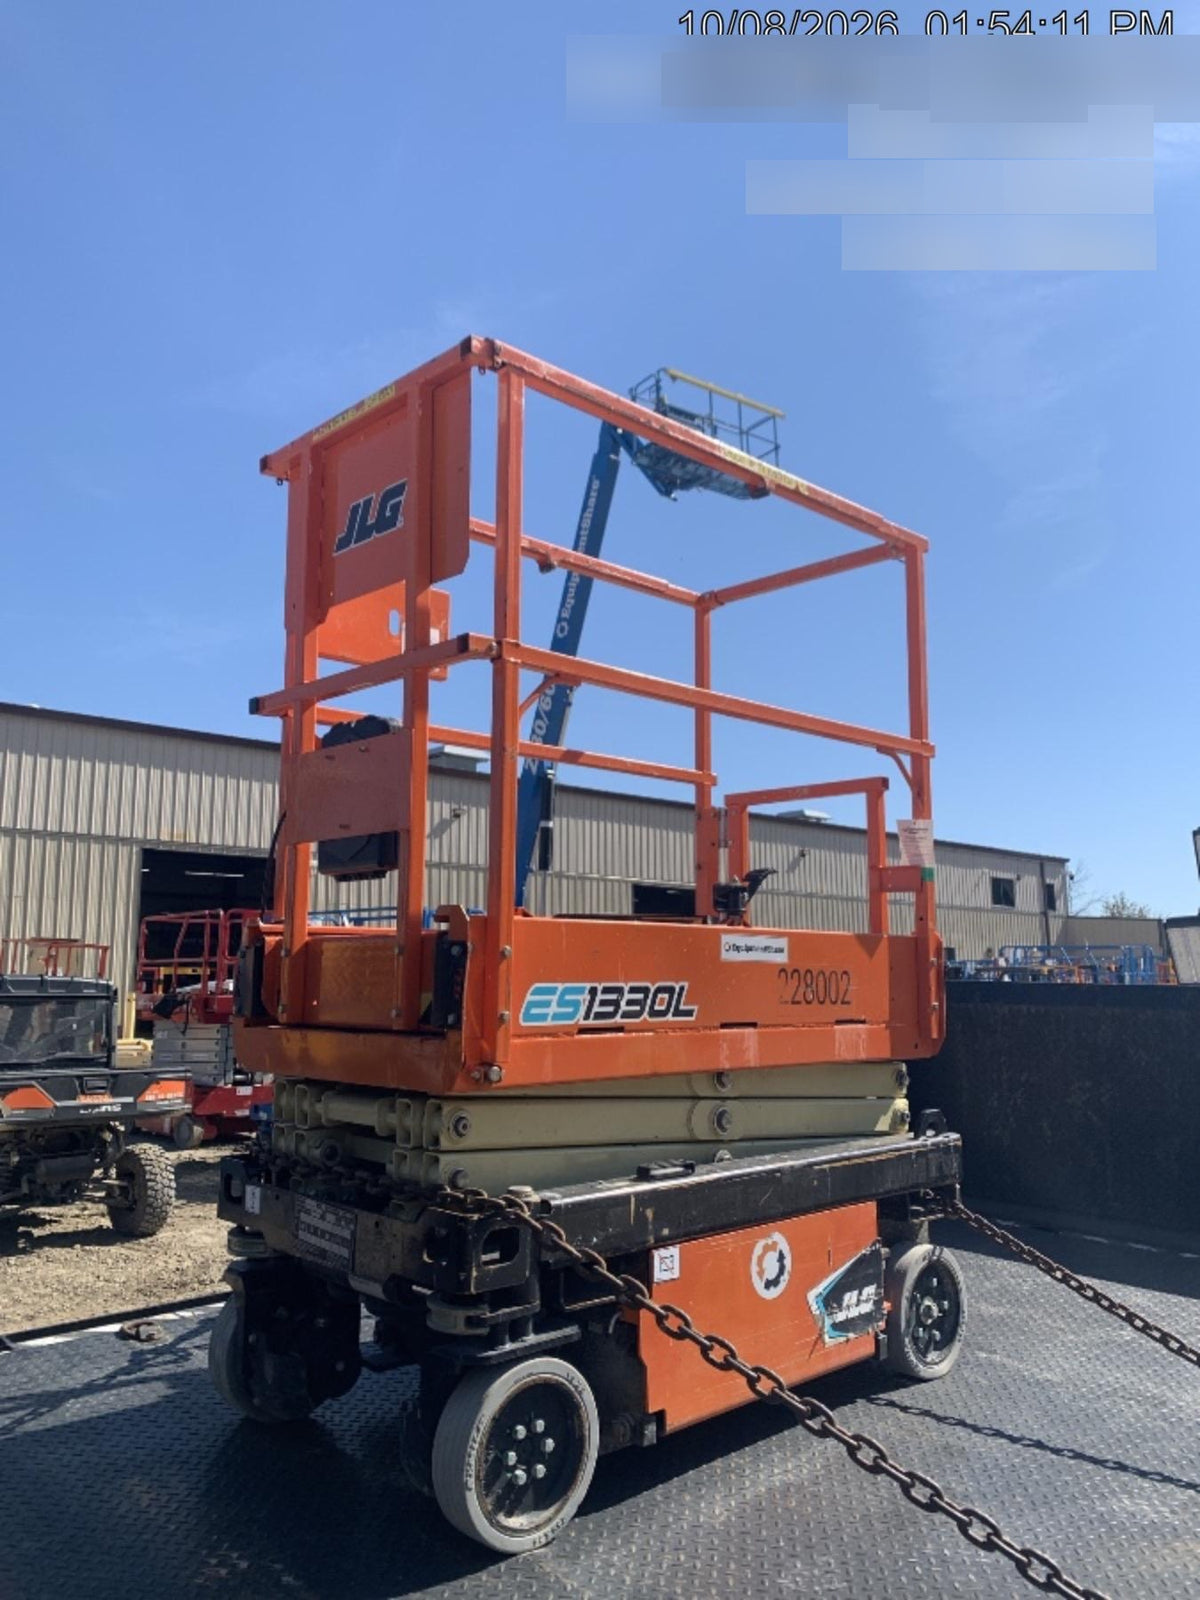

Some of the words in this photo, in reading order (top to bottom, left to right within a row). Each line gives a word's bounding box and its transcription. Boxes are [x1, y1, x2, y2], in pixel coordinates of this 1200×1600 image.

[333, 478, 408, 556] JLG
[561, 477, 601, 619] EquipntShare
[519, 981, 697, 1026] ES1330L
[778, 967, 852, 1005] 228002
